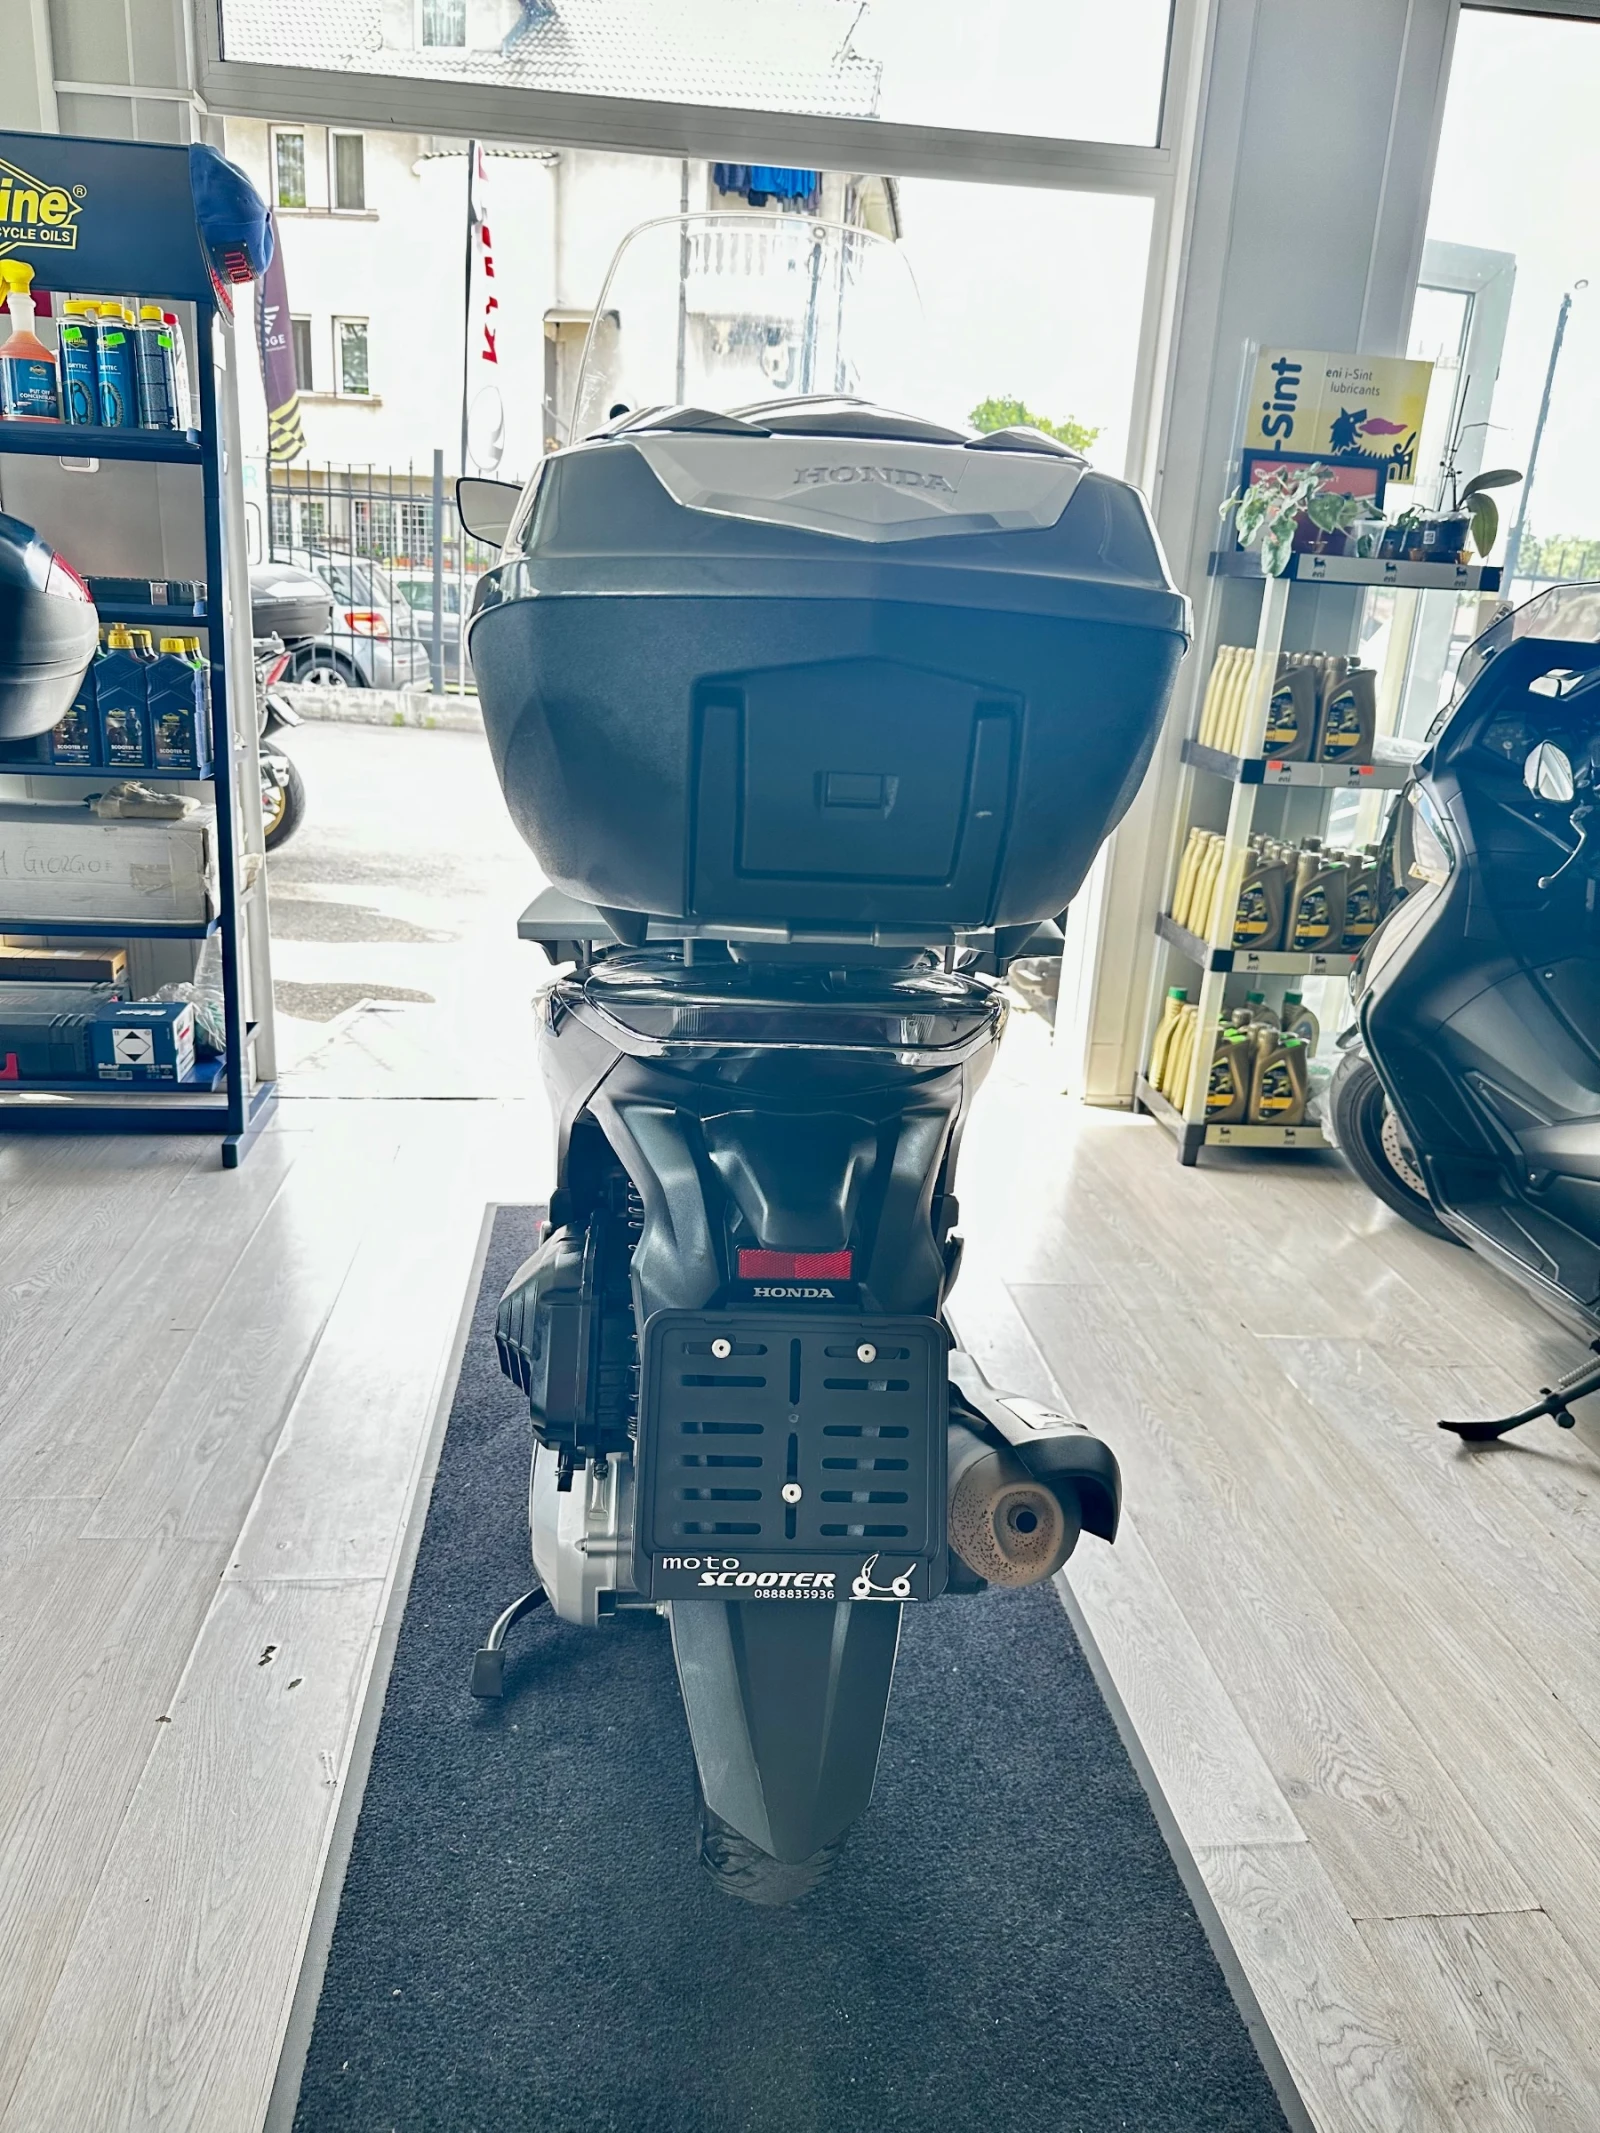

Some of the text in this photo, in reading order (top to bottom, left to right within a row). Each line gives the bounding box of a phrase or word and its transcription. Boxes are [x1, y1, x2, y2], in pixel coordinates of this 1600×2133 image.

[0, 178, 68, 225] ine
[40, 229, 71, 242] OILS
[1326, 367, 1373, 381] eni i-Sint
[1330, 381, 1380, 396] lubricants
[1261, 357, 1302, 452] -Sint
[793, 466, 958, 493] HONDA
[1312, 570, 1326, 578] eni
[1383, 574, 1397, 583] eni
[753, 1287, 835, 1298] HONDA
[662, 1556, 740, 1570] moto
[698, 1572, 836, 1587] SCOOTER
[754, 1589, 836, 1600] 0888835936
